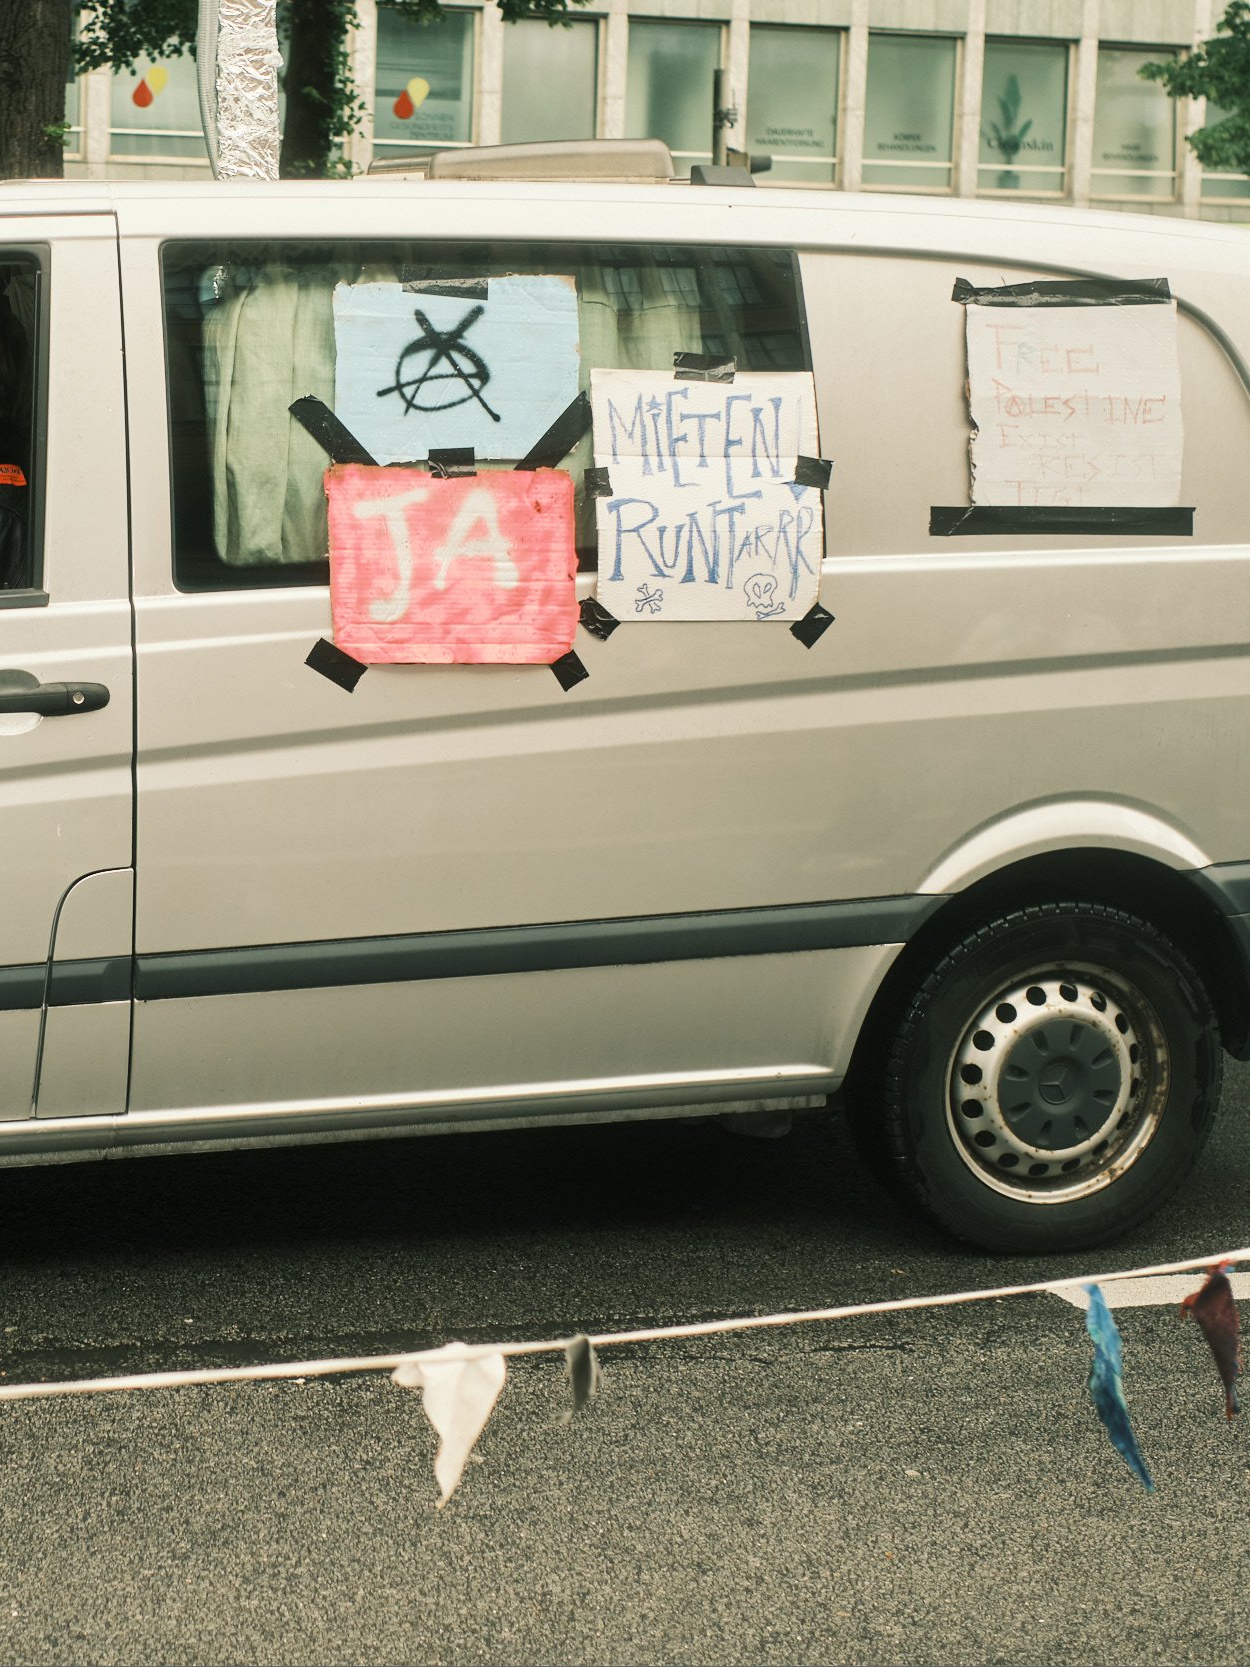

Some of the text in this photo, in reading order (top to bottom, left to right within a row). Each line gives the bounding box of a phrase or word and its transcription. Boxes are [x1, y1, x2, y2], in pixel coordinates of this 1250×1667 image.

[985, 323, 1100, 376] FREE
[991, 378, 1167, 425] PALESTINE
[352, 486, 520, 623] JA
